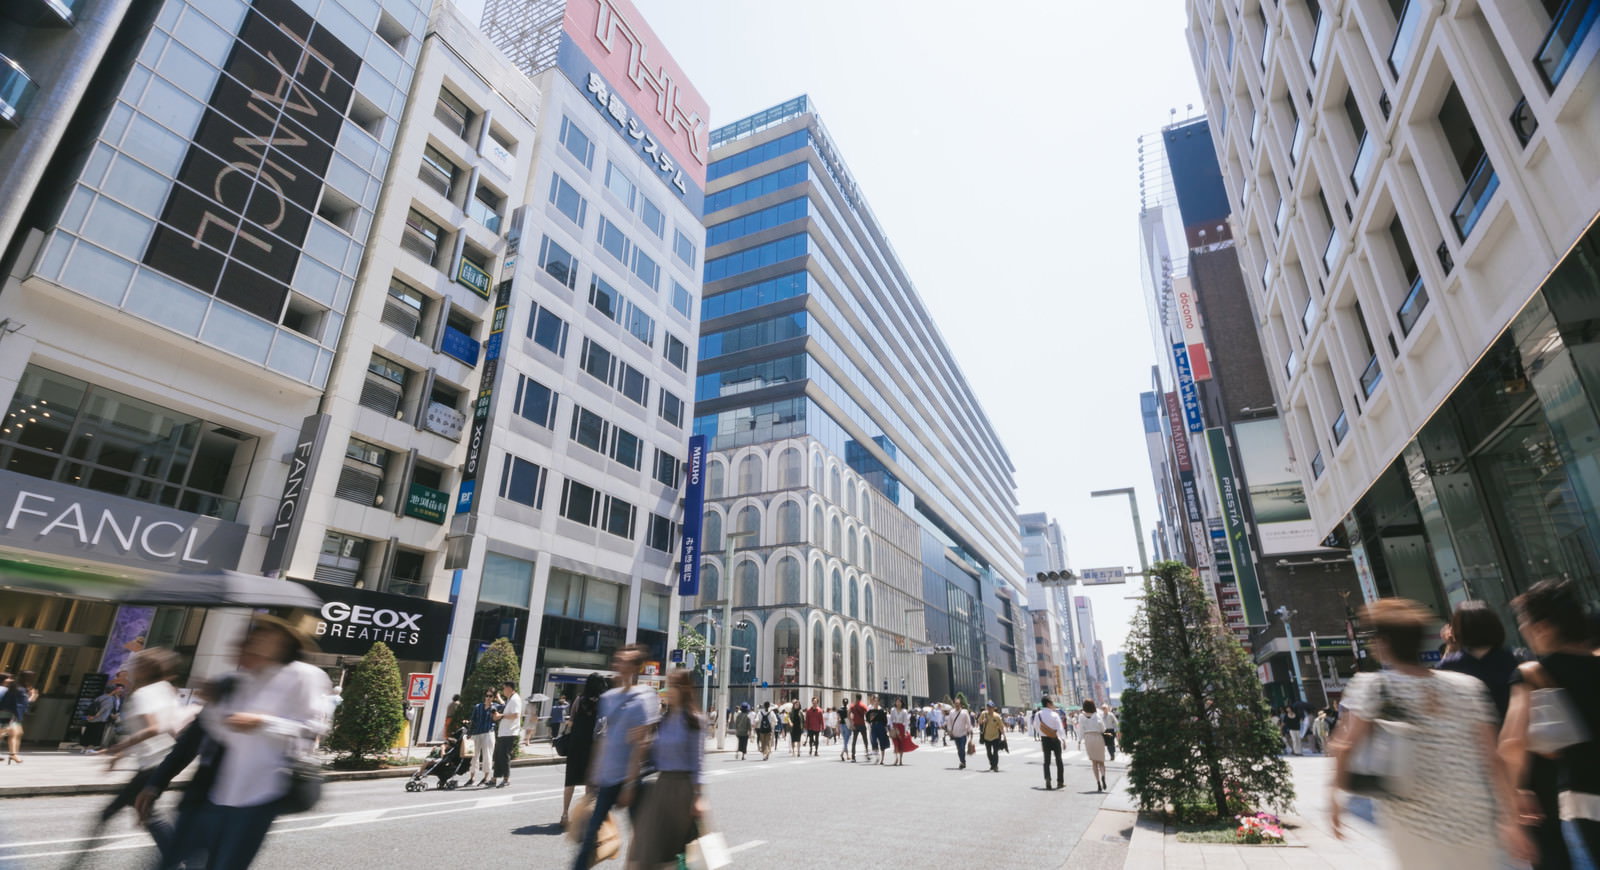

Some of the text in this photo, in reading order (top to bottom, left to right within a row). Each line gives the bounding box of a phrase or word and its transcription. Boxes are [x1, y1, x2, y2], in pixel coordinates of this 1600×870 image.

[192, 22, 335, 253] FANCL
[1179, 291, 1195, 330] docomo
[468, 425, 482, 473] GEOX
[691, 446, 702, 485] MIZUHO
[271, 441, 312, 540] FANCL
[5, 490, 209, 564] FANCL
[683, 537, 694, 582] みずほ銀行
[315, 622, 419, 645] BREATHES
[321, 601, 423, 631] GEOX
